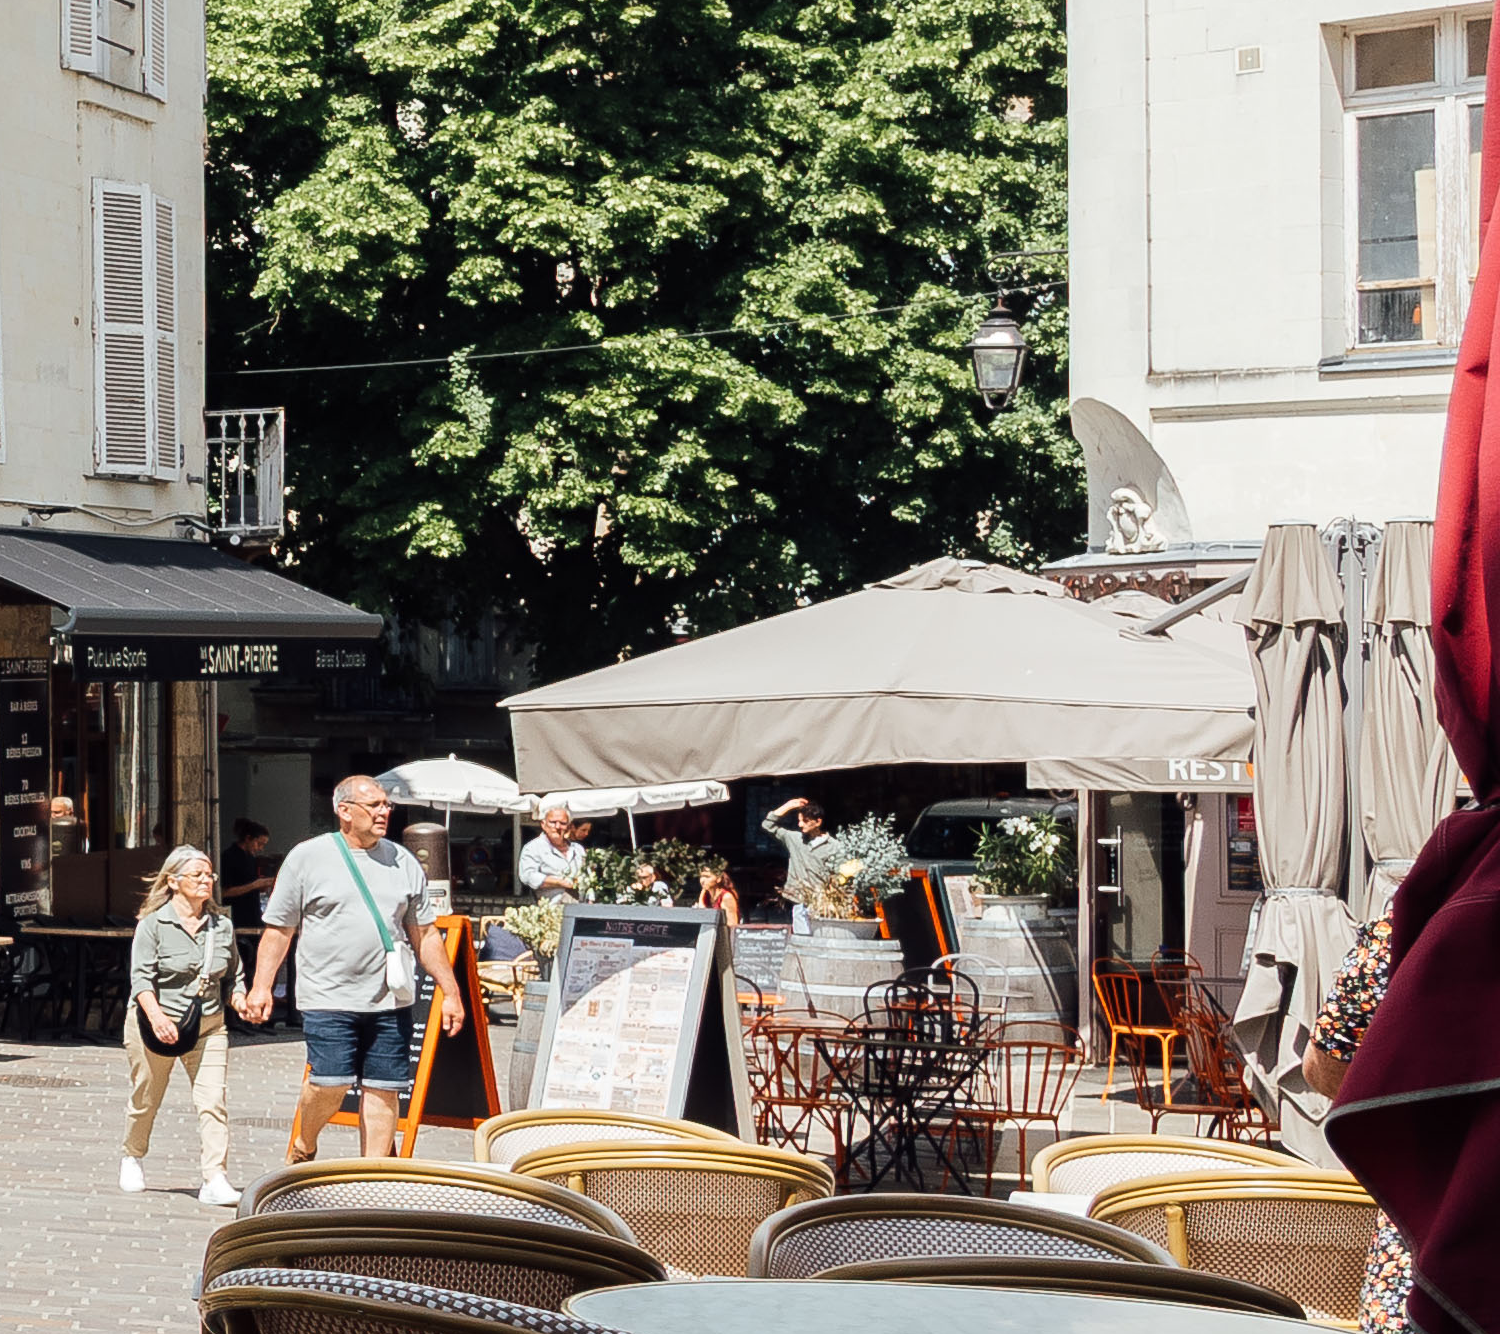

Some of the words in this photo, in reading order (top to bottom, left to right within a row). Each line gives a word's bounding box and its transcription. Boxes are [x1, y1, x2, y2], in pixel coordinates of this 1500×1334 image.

[208, 644, 279, 673] SAINT-PIERRE
[605, 921, 635, 933] NOTRE
[637, 922, 669, 934] CARTE
